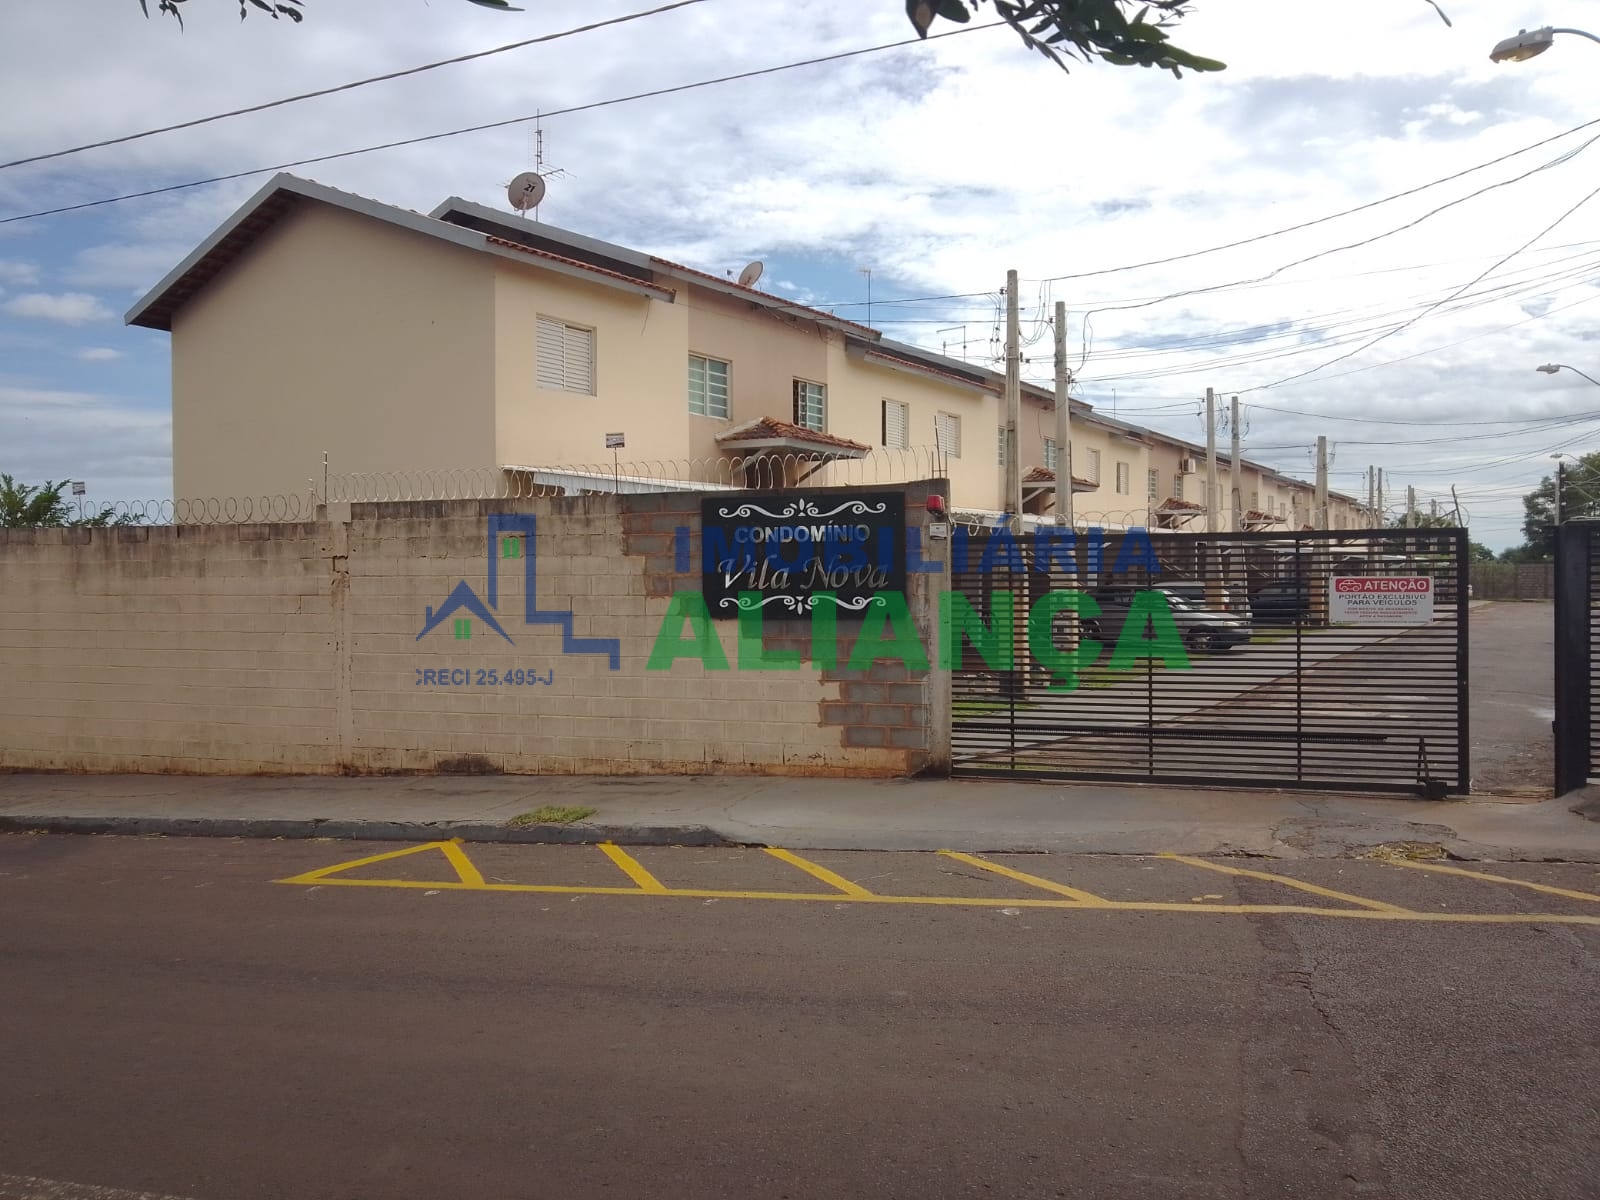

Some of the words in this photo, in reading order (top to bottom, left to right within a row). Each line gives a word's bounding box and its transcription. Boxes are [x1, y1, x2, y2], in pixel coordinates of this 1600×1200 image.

[734, 520, 871, 543] CONDOMÍNIO
[717, 554, 791, 590] Vila
[800, 554, 889, 591] Nova
[1364, 579, 1427, 592] ATENÇÃO
